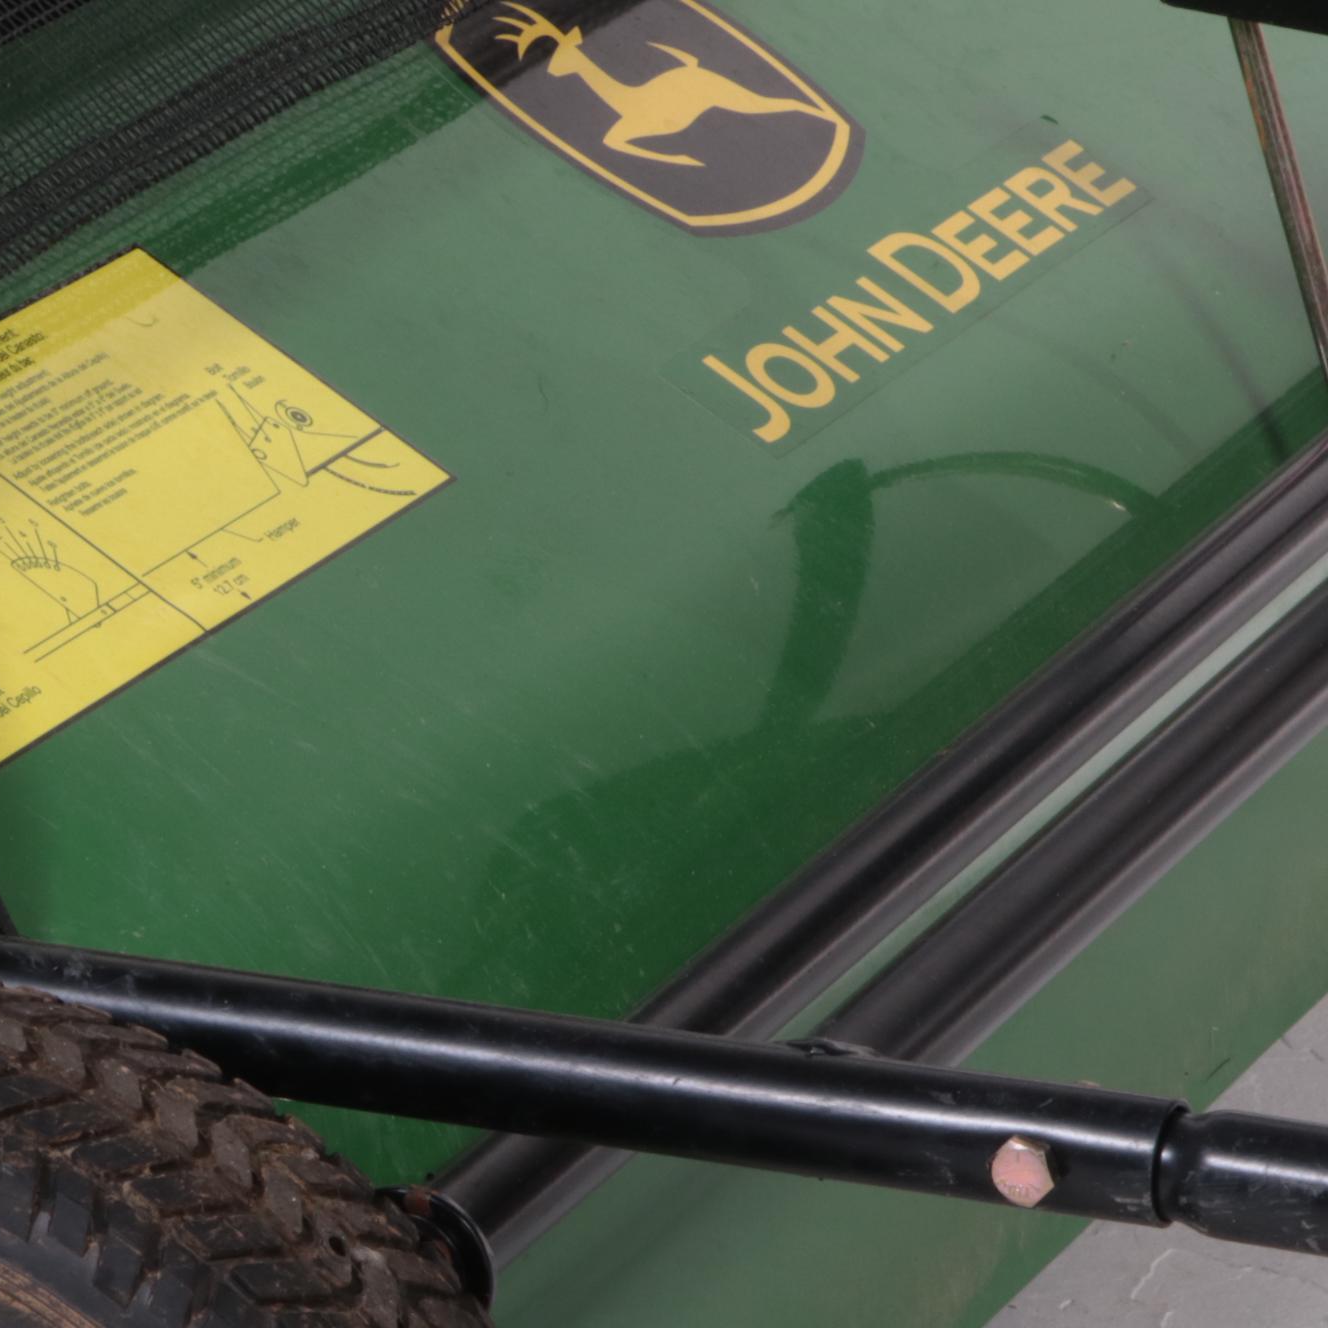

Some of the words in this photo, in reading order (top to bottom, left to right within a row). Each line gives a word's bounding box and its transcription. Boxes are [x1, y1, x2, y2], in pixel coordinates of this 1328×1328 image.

[703, 277, 934, 443] JOHN
[867, 139, 1136, 313] DEERE
[264, 517, 300, 541] Hamper
[202, 557, 241, 582] minimum
[233, 574, 249, 586] cm
[6, 686, 42, 709] Cepillo
